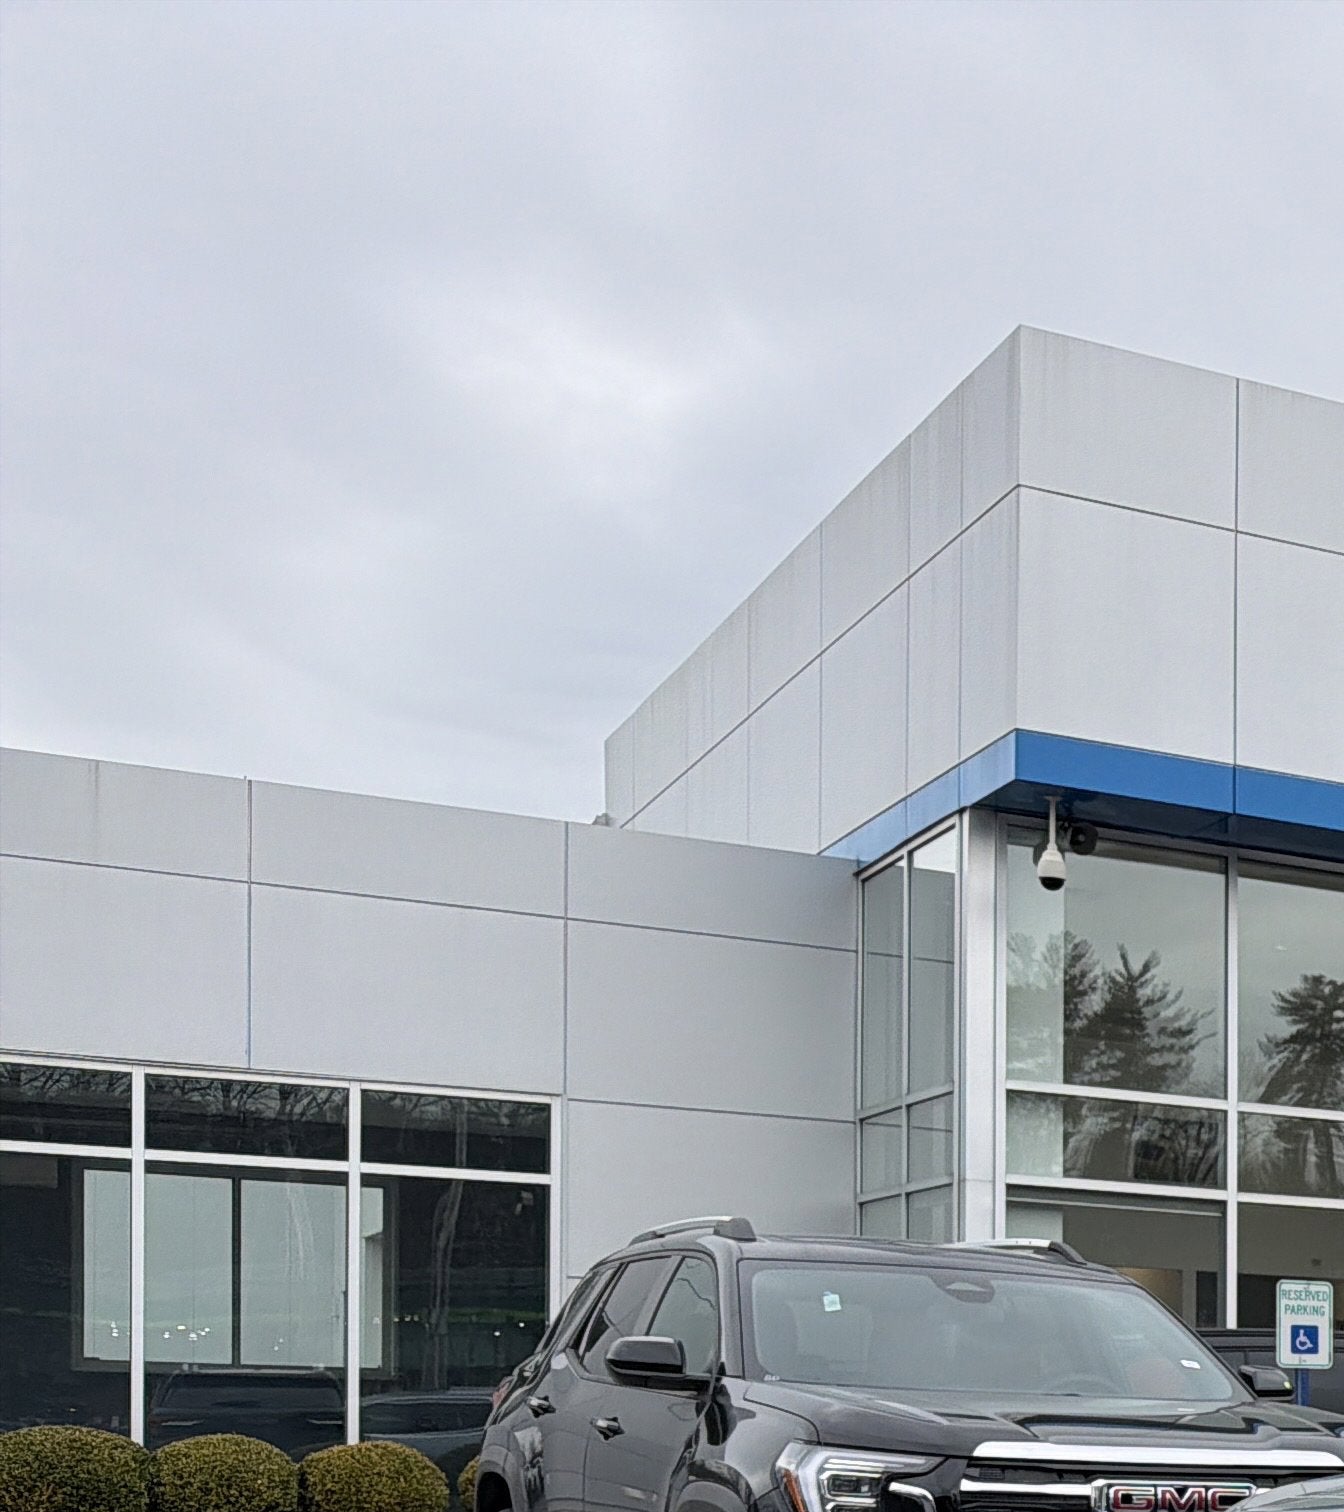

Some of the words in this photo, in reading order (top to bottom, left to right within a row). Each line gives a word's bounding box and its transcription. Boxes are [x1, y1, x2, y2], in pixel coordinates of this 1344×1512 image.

[1281, 1289, 1329, 1302] RESERVED
[1284, 1304, 1326, 1316] PARKING
[1109, 1485, 1251, 1512] GMC
